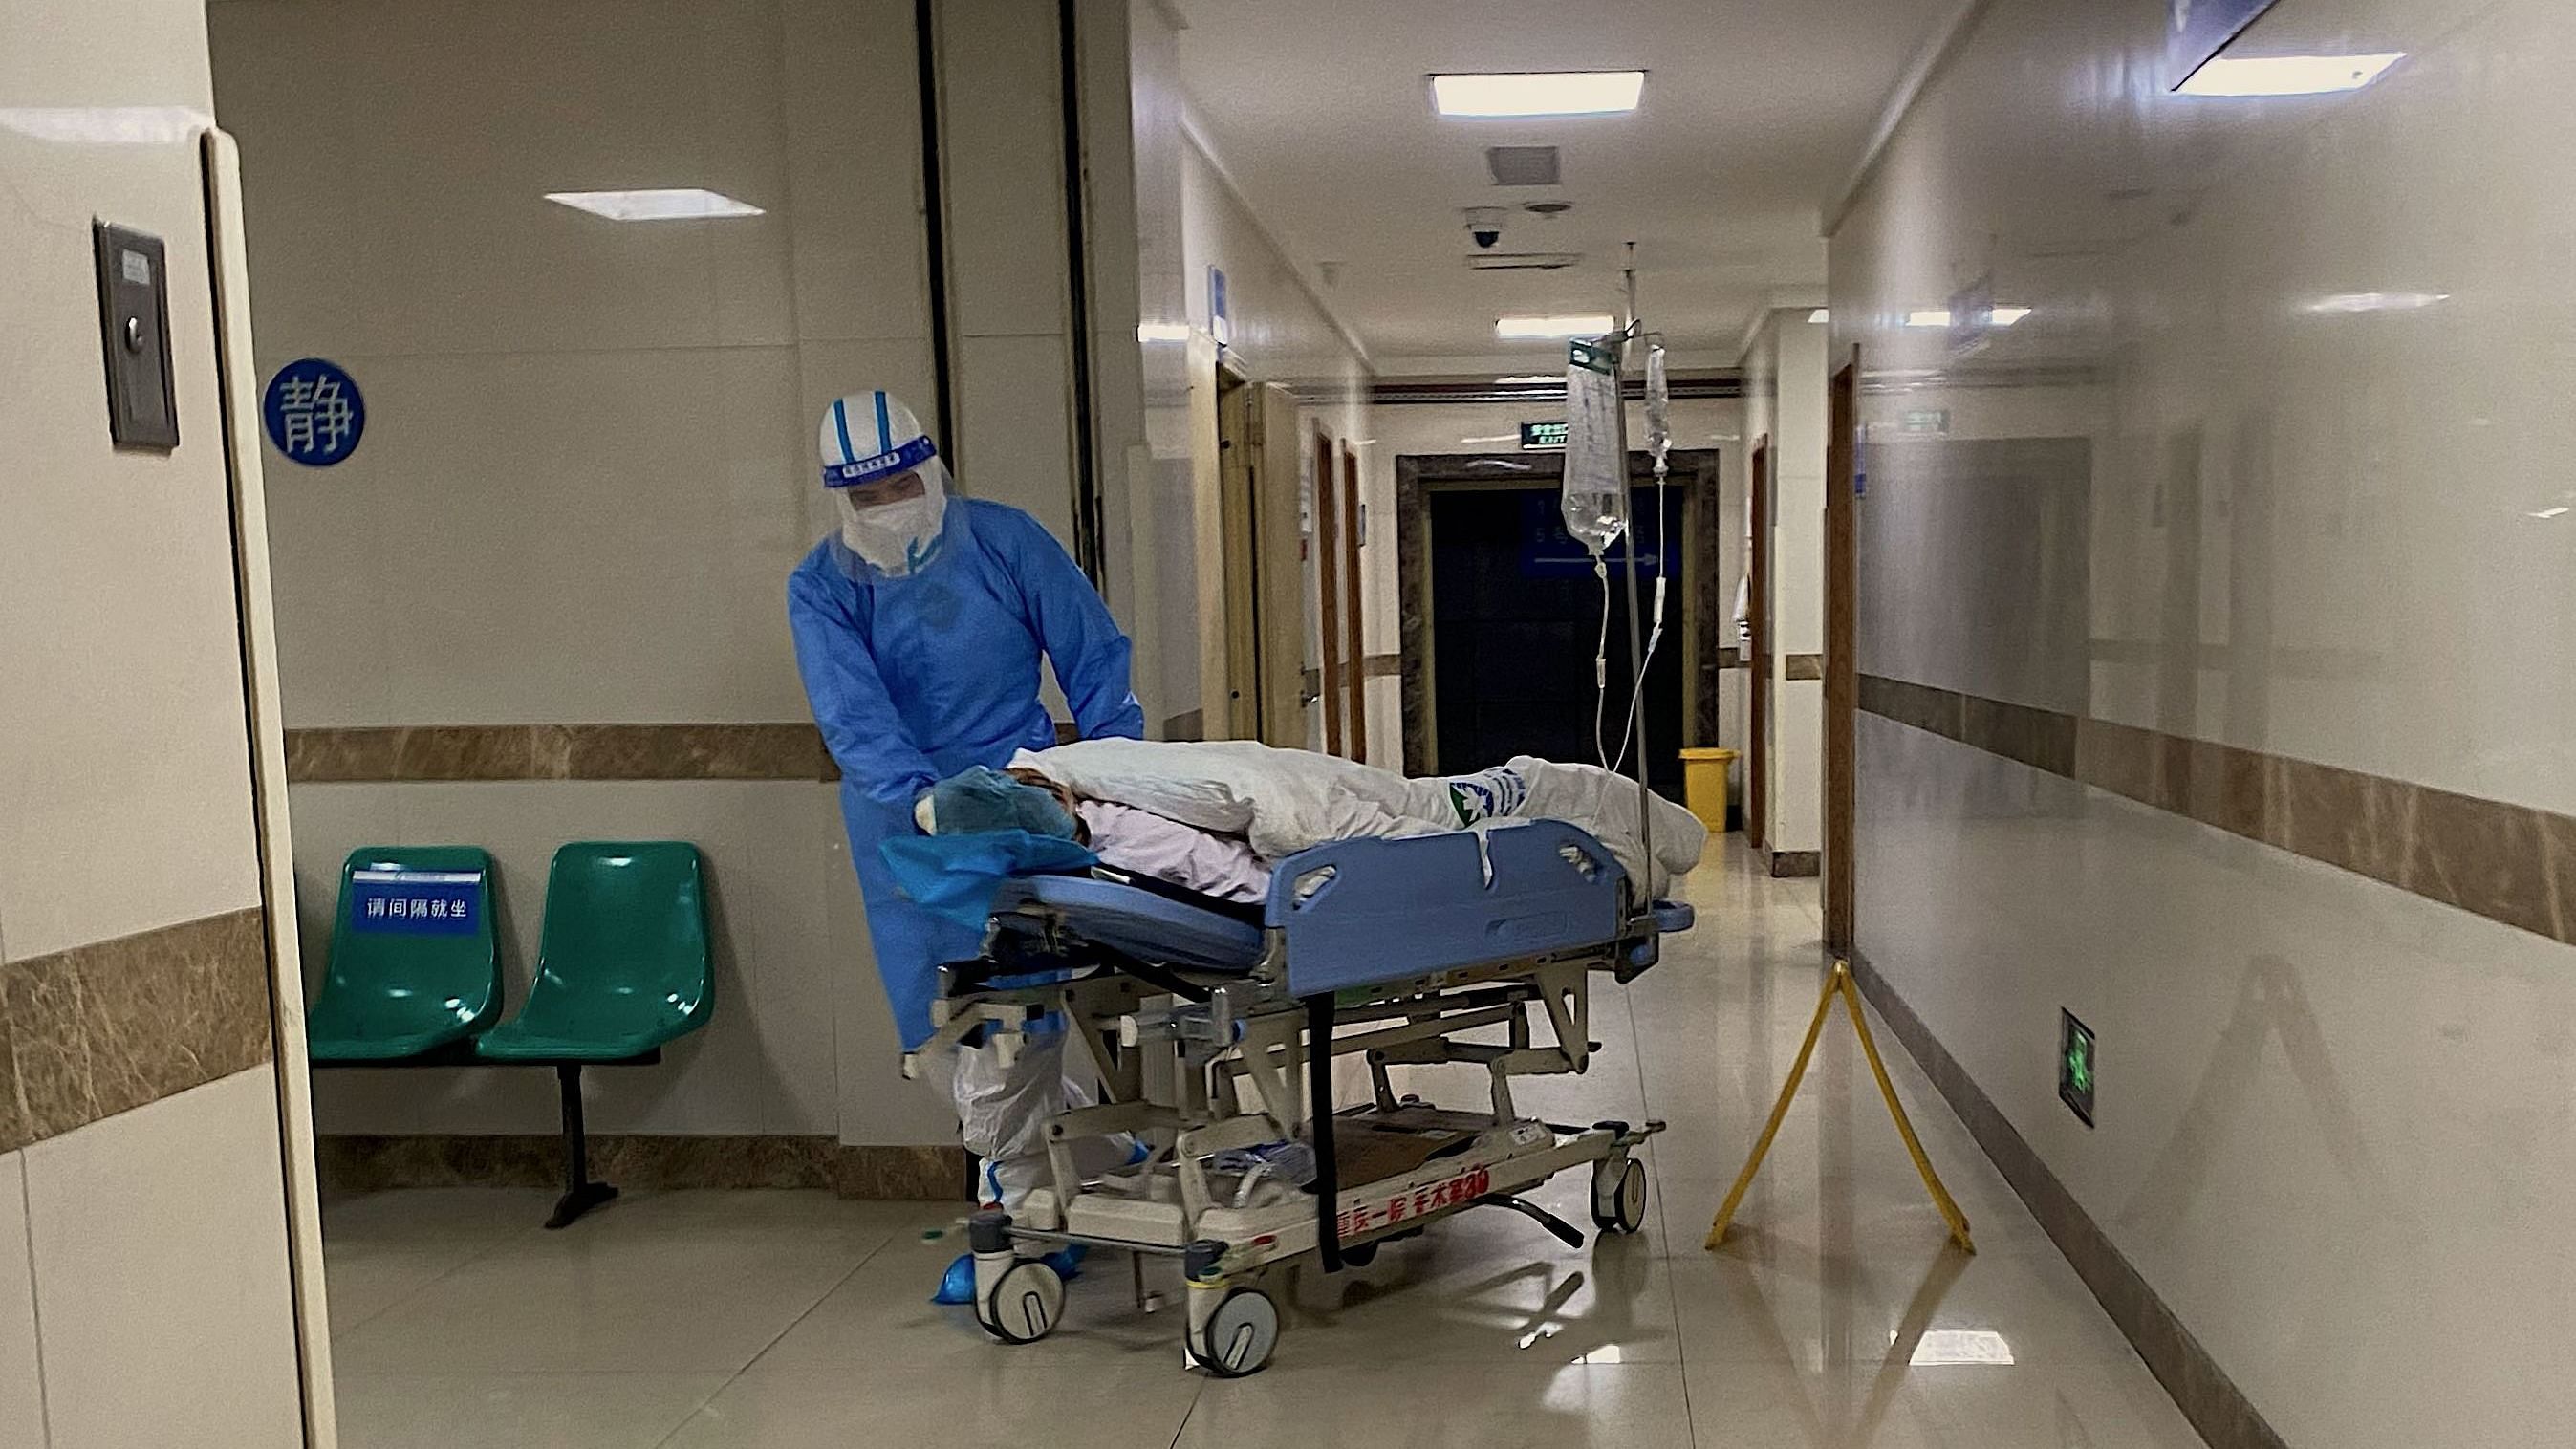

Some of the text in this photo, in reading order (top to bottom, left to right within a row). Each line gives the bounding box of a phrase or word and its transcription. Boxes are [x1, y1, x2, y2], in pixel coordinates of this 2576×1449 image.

[279, 374, 354, 454] 静
[367, 898, 466, 919] 请间隔就坐
